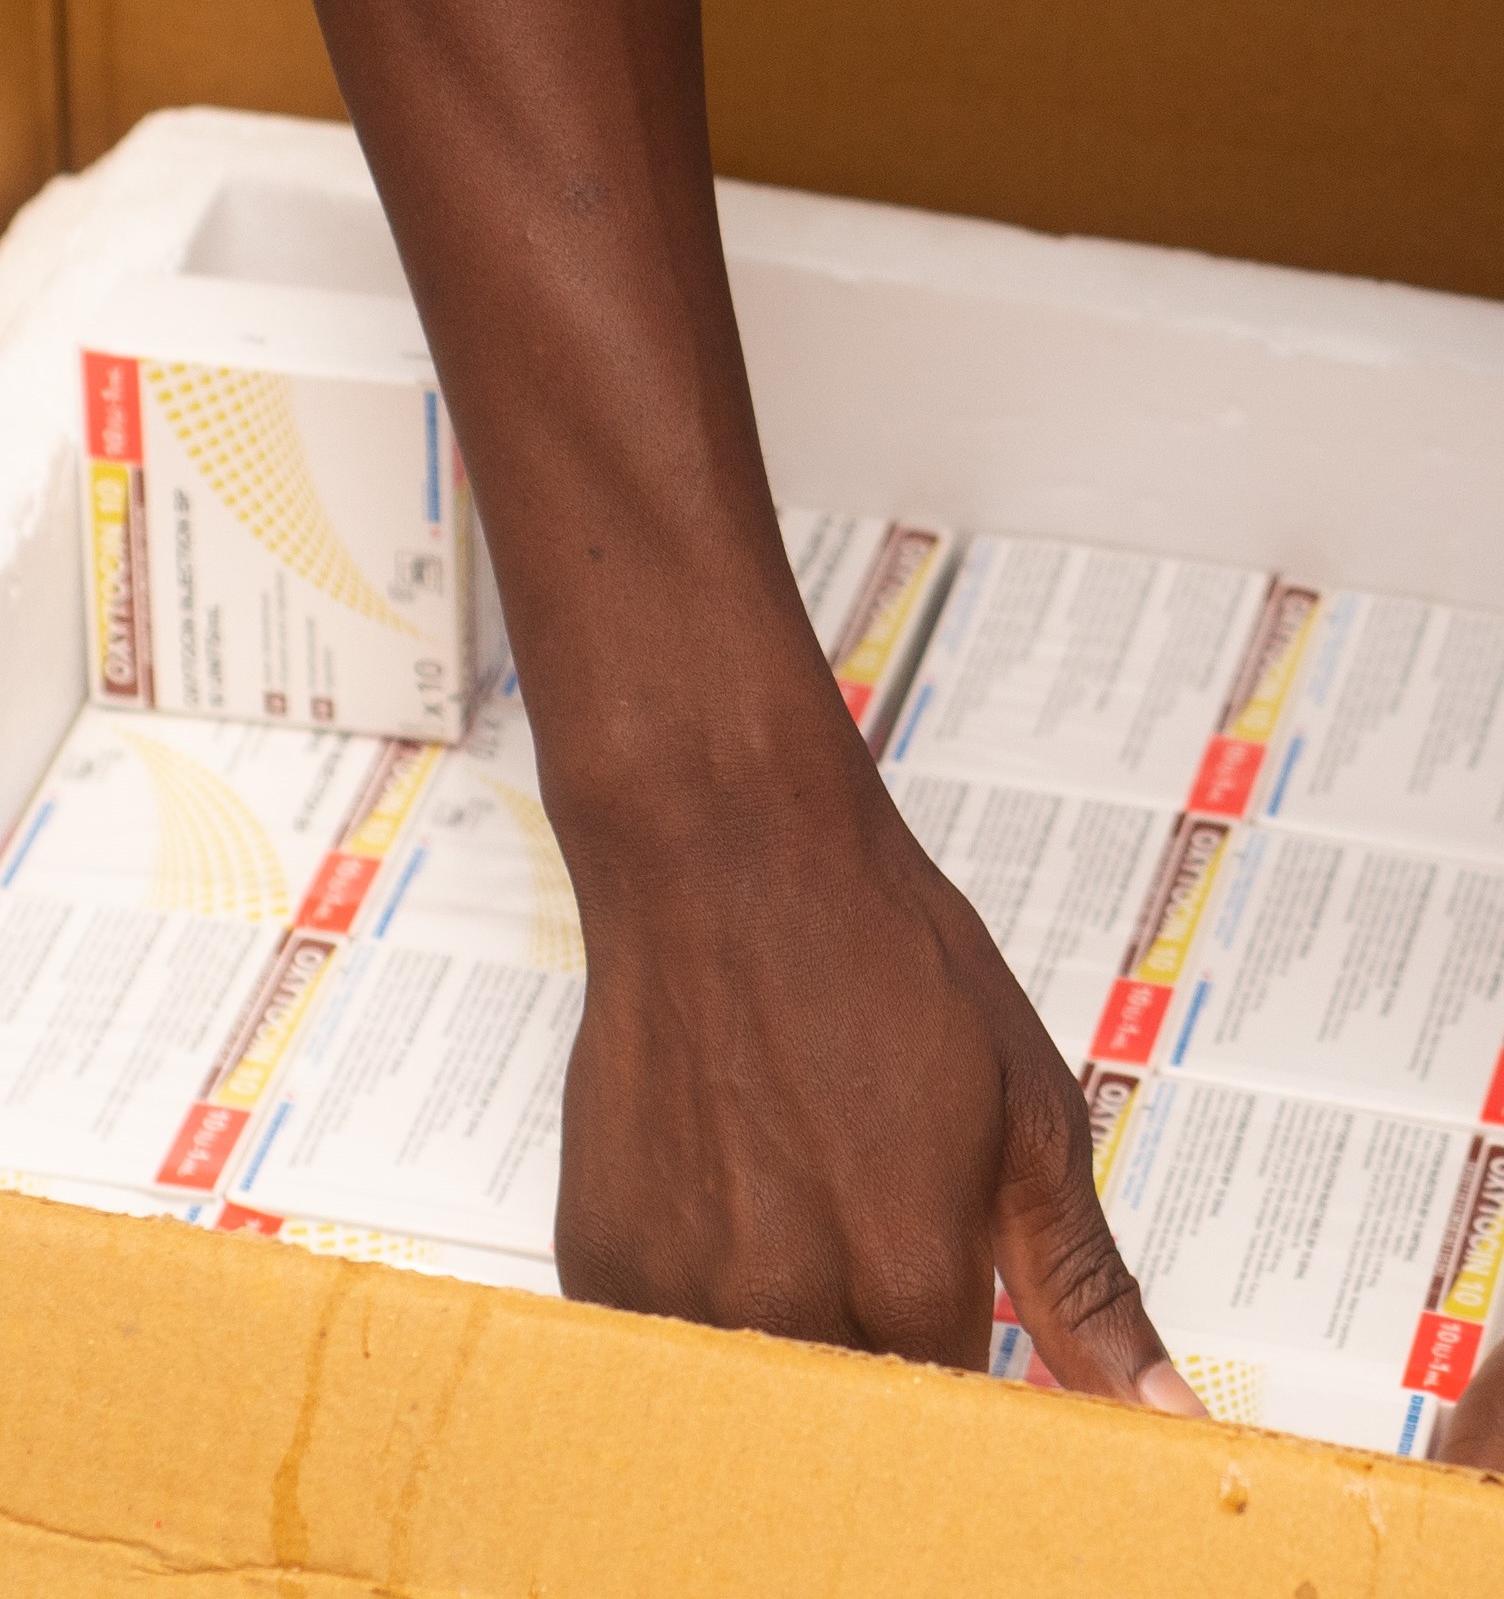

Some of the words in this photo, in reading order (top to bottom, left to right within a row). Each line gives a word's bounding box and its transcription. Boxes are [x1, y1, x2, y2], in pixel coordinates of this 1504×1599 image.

[97, 476, 125, 515] 10
[98, 520, 133, 687] OXYTOCIN
[1453, 1279, 1486, 1307] 10
